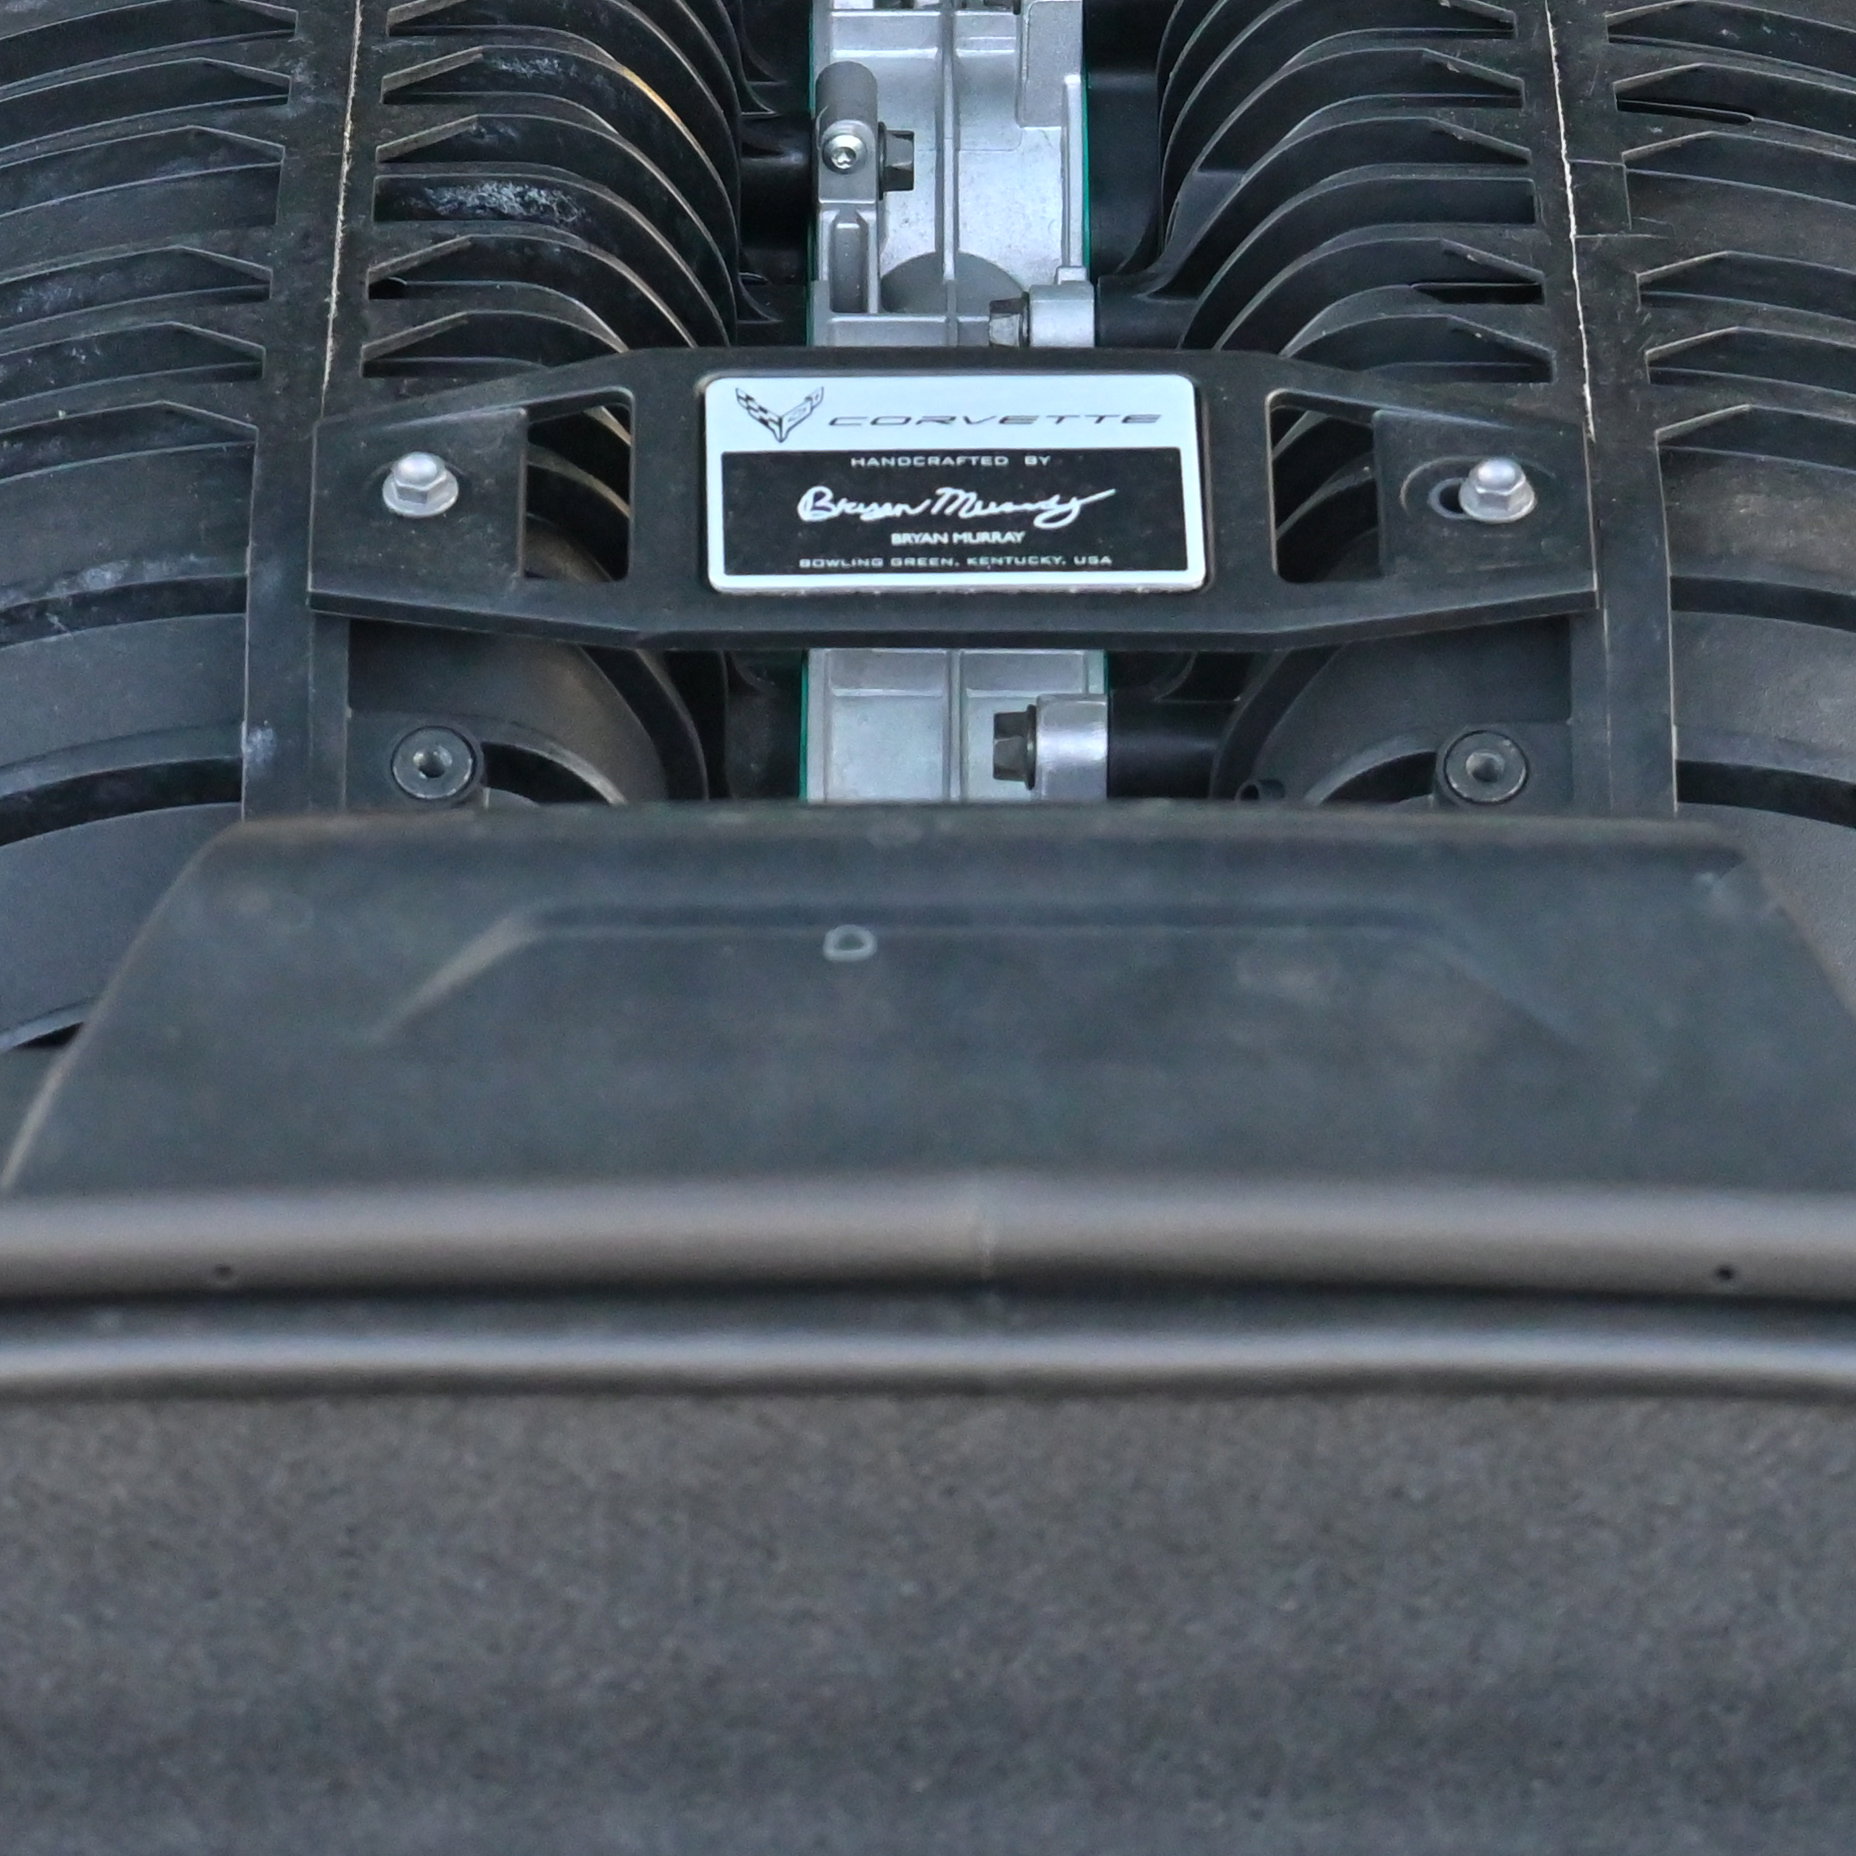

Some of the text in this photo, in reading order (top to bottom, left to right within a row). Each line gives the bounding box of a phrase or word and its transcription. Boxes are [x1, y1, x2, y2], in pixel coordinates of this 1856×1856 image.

[828, 413, 1162, 426] CORVETTE
[850, 455, 1051, 467] HANDCRAFTED BY
[890, 531, 1026, 546] BRYAN MURRAY
[799, 557, 884, 569] BOWLING
[1073, 555, 1112, 566] USA
